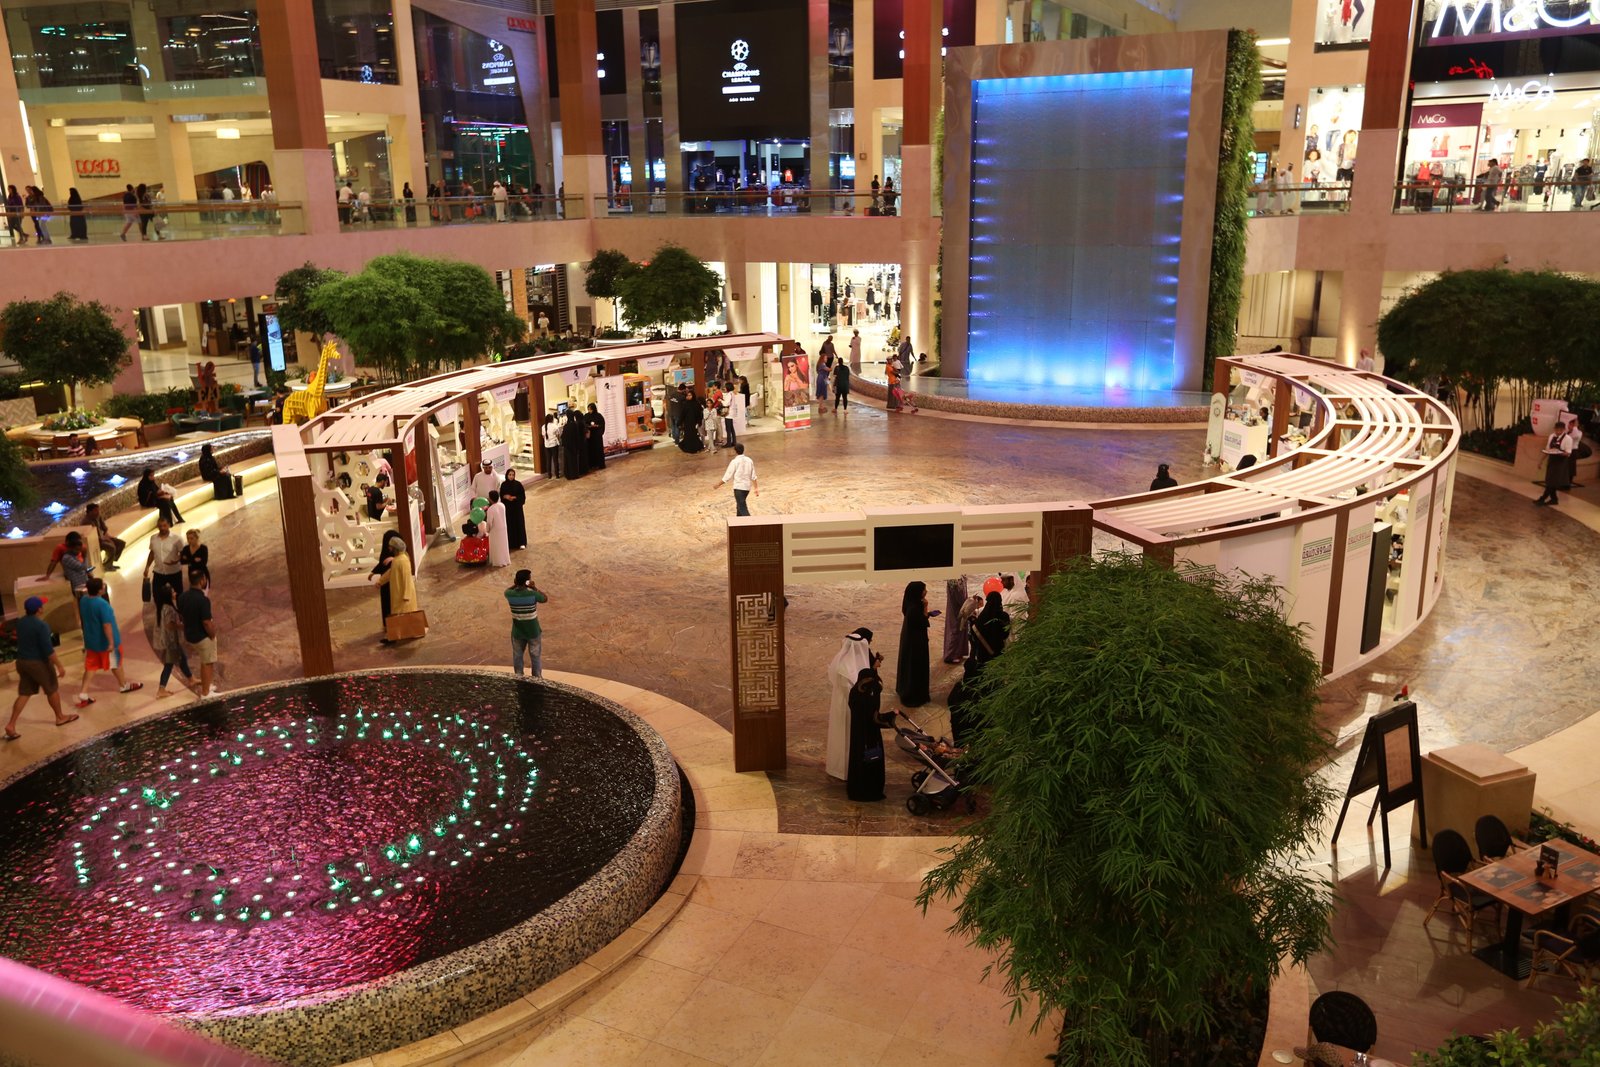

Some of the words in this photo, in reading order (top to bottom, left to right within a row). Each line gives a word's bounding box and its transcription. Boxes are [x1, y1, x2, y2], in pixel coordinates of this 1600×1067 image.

[1432, 0, 1600, 38] M&C
[722, 69, 760, 78] CHAMPIONS
[1488, 81, 1554, 103] M&Co
[1418, 114, 1447, 124] M&Co
